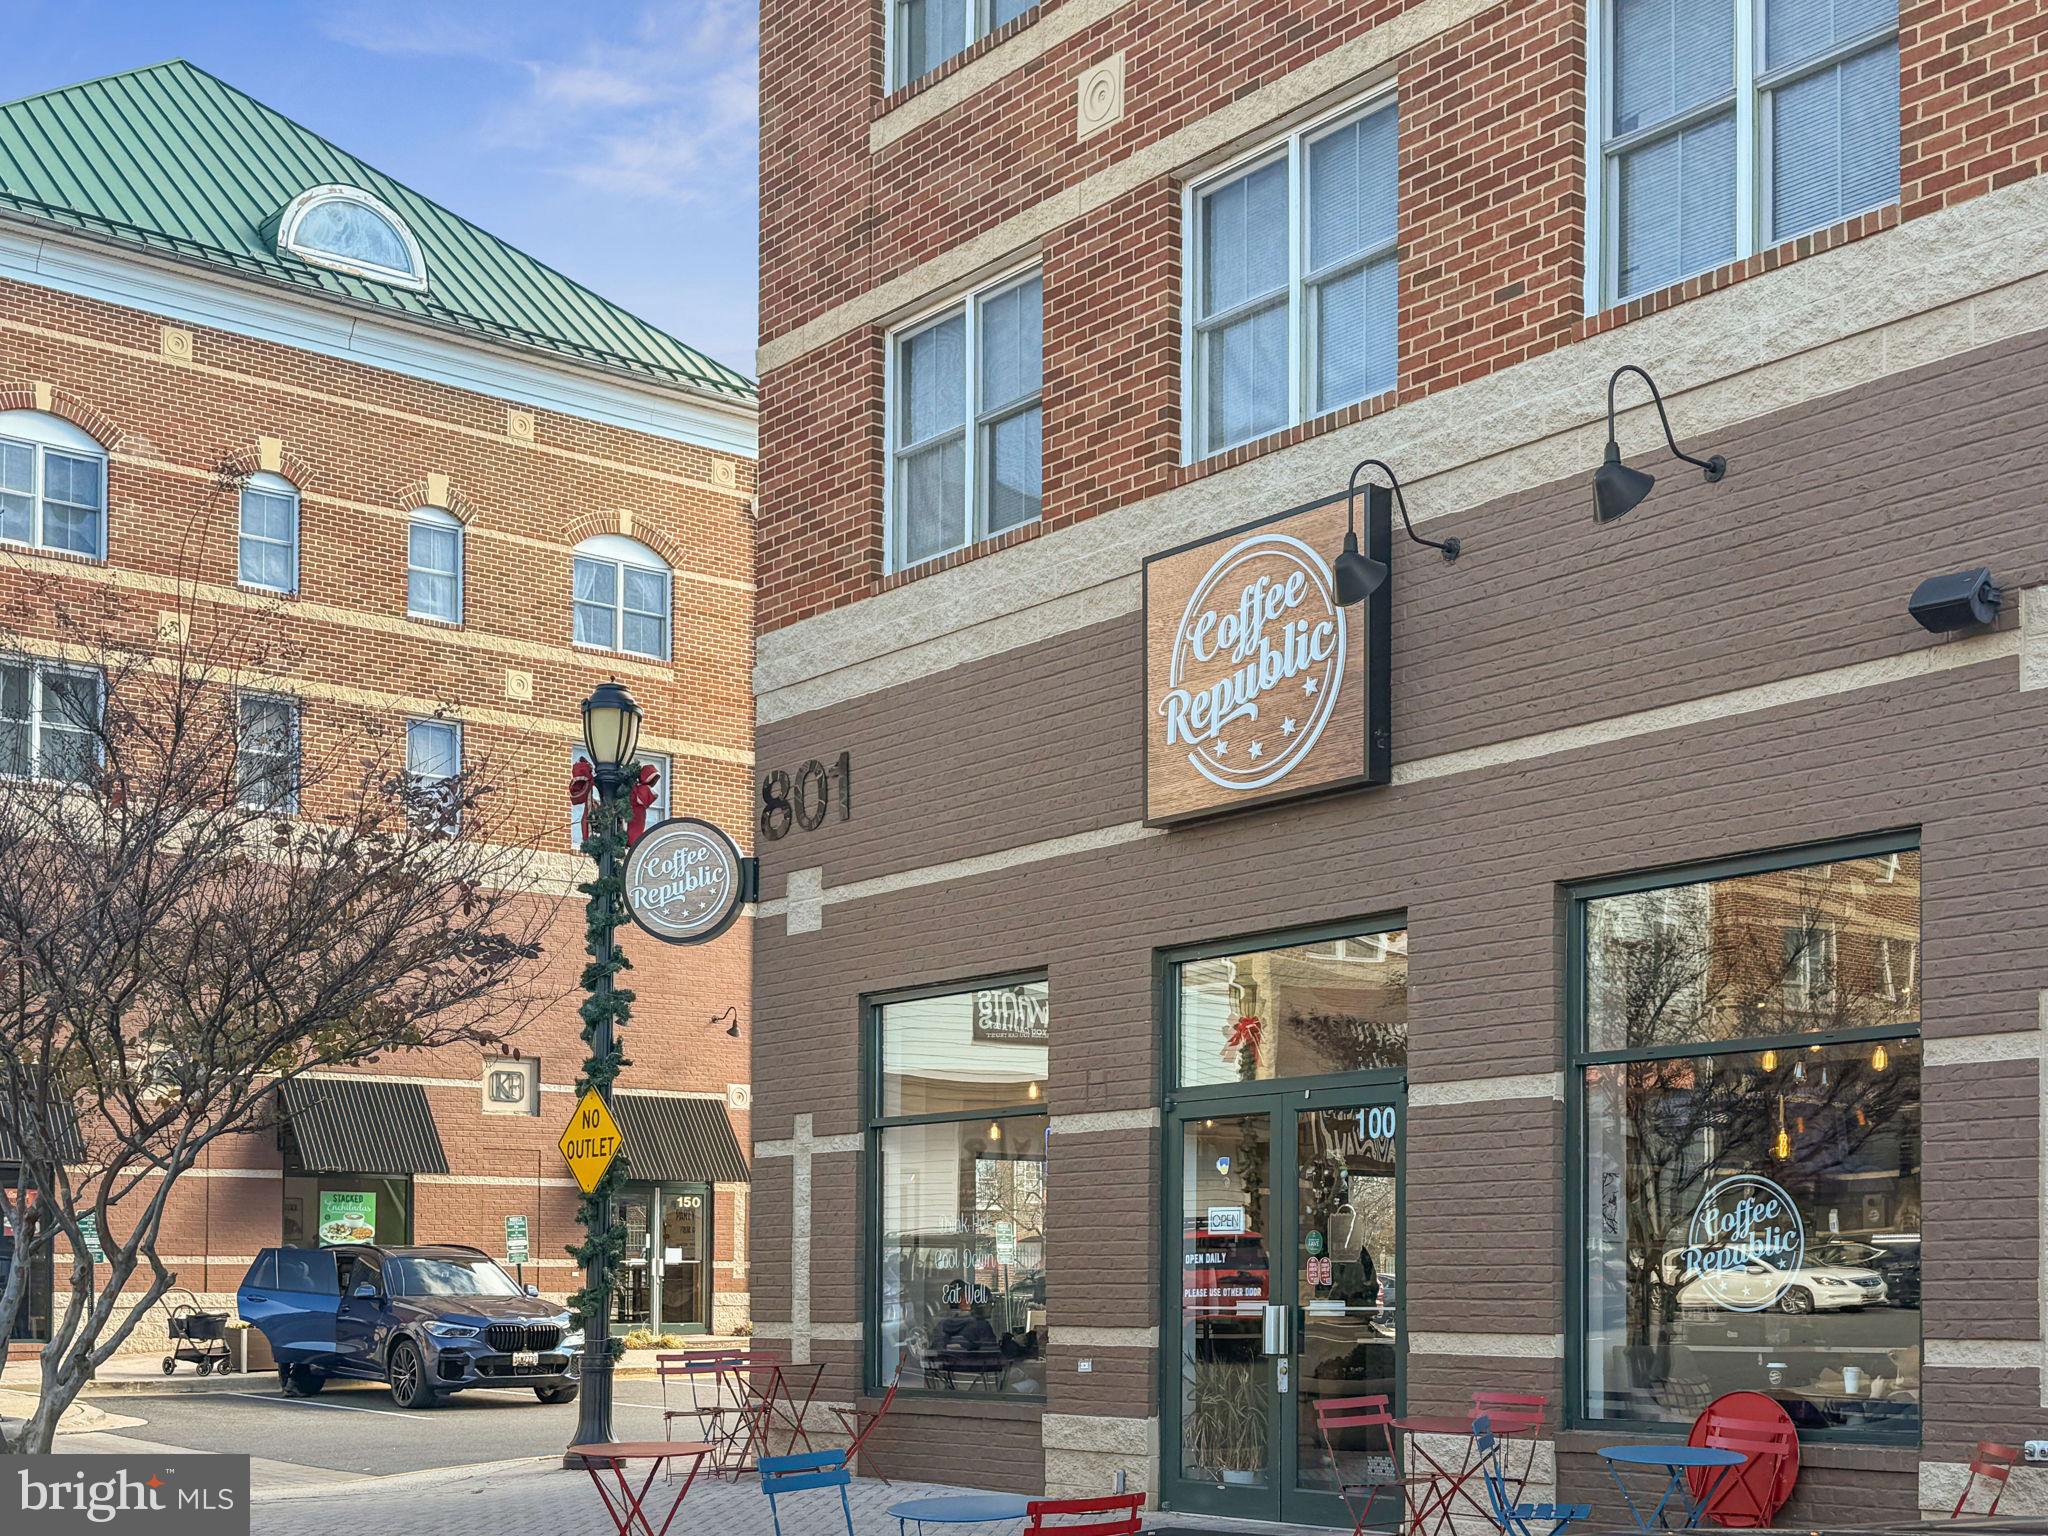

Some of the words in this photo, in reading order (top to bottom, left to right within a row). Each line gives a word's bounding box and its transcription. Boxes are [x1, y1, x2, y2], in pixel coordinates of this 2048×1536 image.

[1185, 570, 1309, 664] Coffee
[1159, 618, 1337, 745] Republic
[760, 751, 849, 841] 801
[643, 846, 710, 879] Coffee
[630, 866, 726, 910] Republic
[582, 1109, 600, 1129] NO
[1355, 1107, 1396, 1141] 100
[567, 1137, 615, 1160] OUTLET
[333, 1194, 364, 1203] STACKED
[677, 1196, 701, 1208] 150
[1212, 1214, 1239, 1228] OPEN
[1700, 1197, 1781, 1241] Coffee
[934, 1248, 960, 1270] Cool
[963, 1248, 996, 1269] Down
[1185, 1253, 1204, 1264] OPEN
[1205, 1252, 1227, 1263] DAILY
[1681, 1226, 1800, 1280] Republic
[942, 1283, 962, 1304] Eat
[964, 1282, 989, 1304] Well
[1184, 1288, 1208, 1297] PLEASE
[1209, 1288, 1222, 1297] USE
[1222, 1288, 1244, 1297] OTHER
[1244, 1287, 1262, 1297] DOOR
